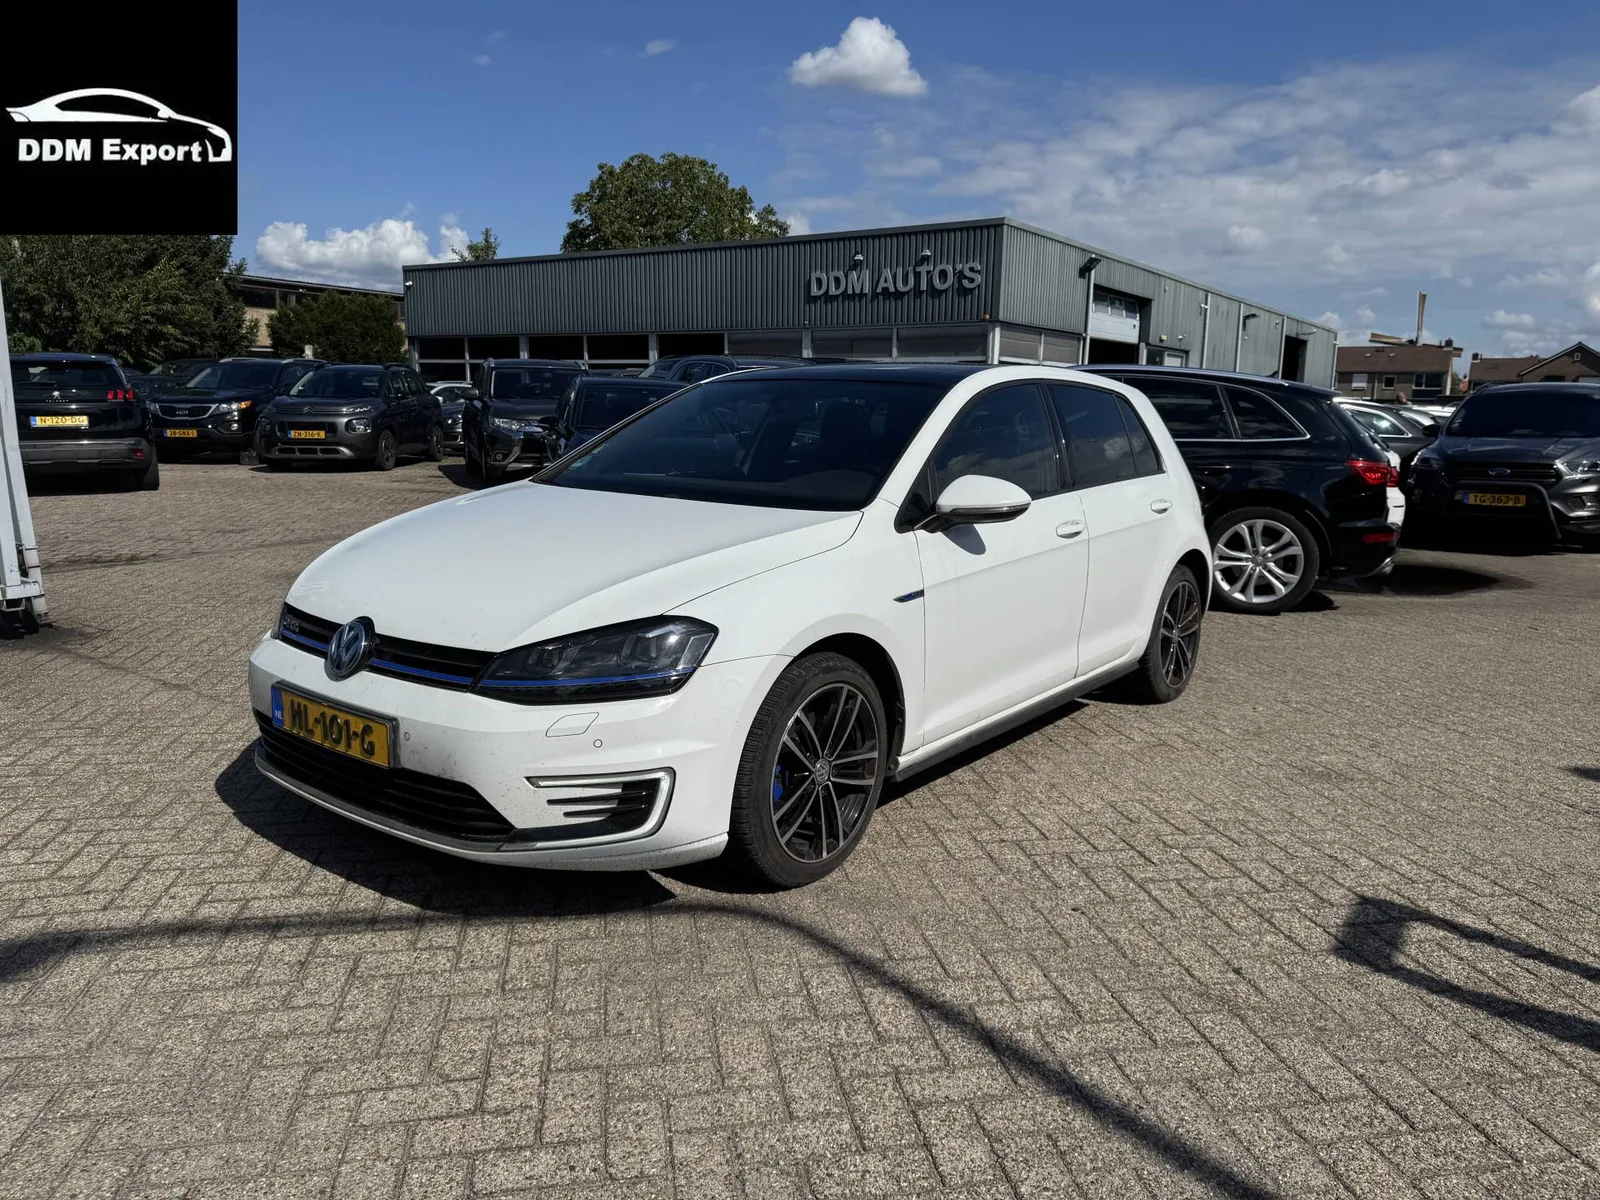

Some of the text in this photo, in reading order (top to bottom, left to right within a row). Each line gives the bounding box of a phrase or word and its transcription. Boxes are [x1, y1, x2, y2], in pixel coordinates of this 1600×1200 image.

[810, 261, 982, 297] DDM AUTO'S
[40, 416, 85, 424] N-120-DG
[1473, 494, 1521, 505] TG-363-B
[289, 698, 376, 757] HL-101-G
